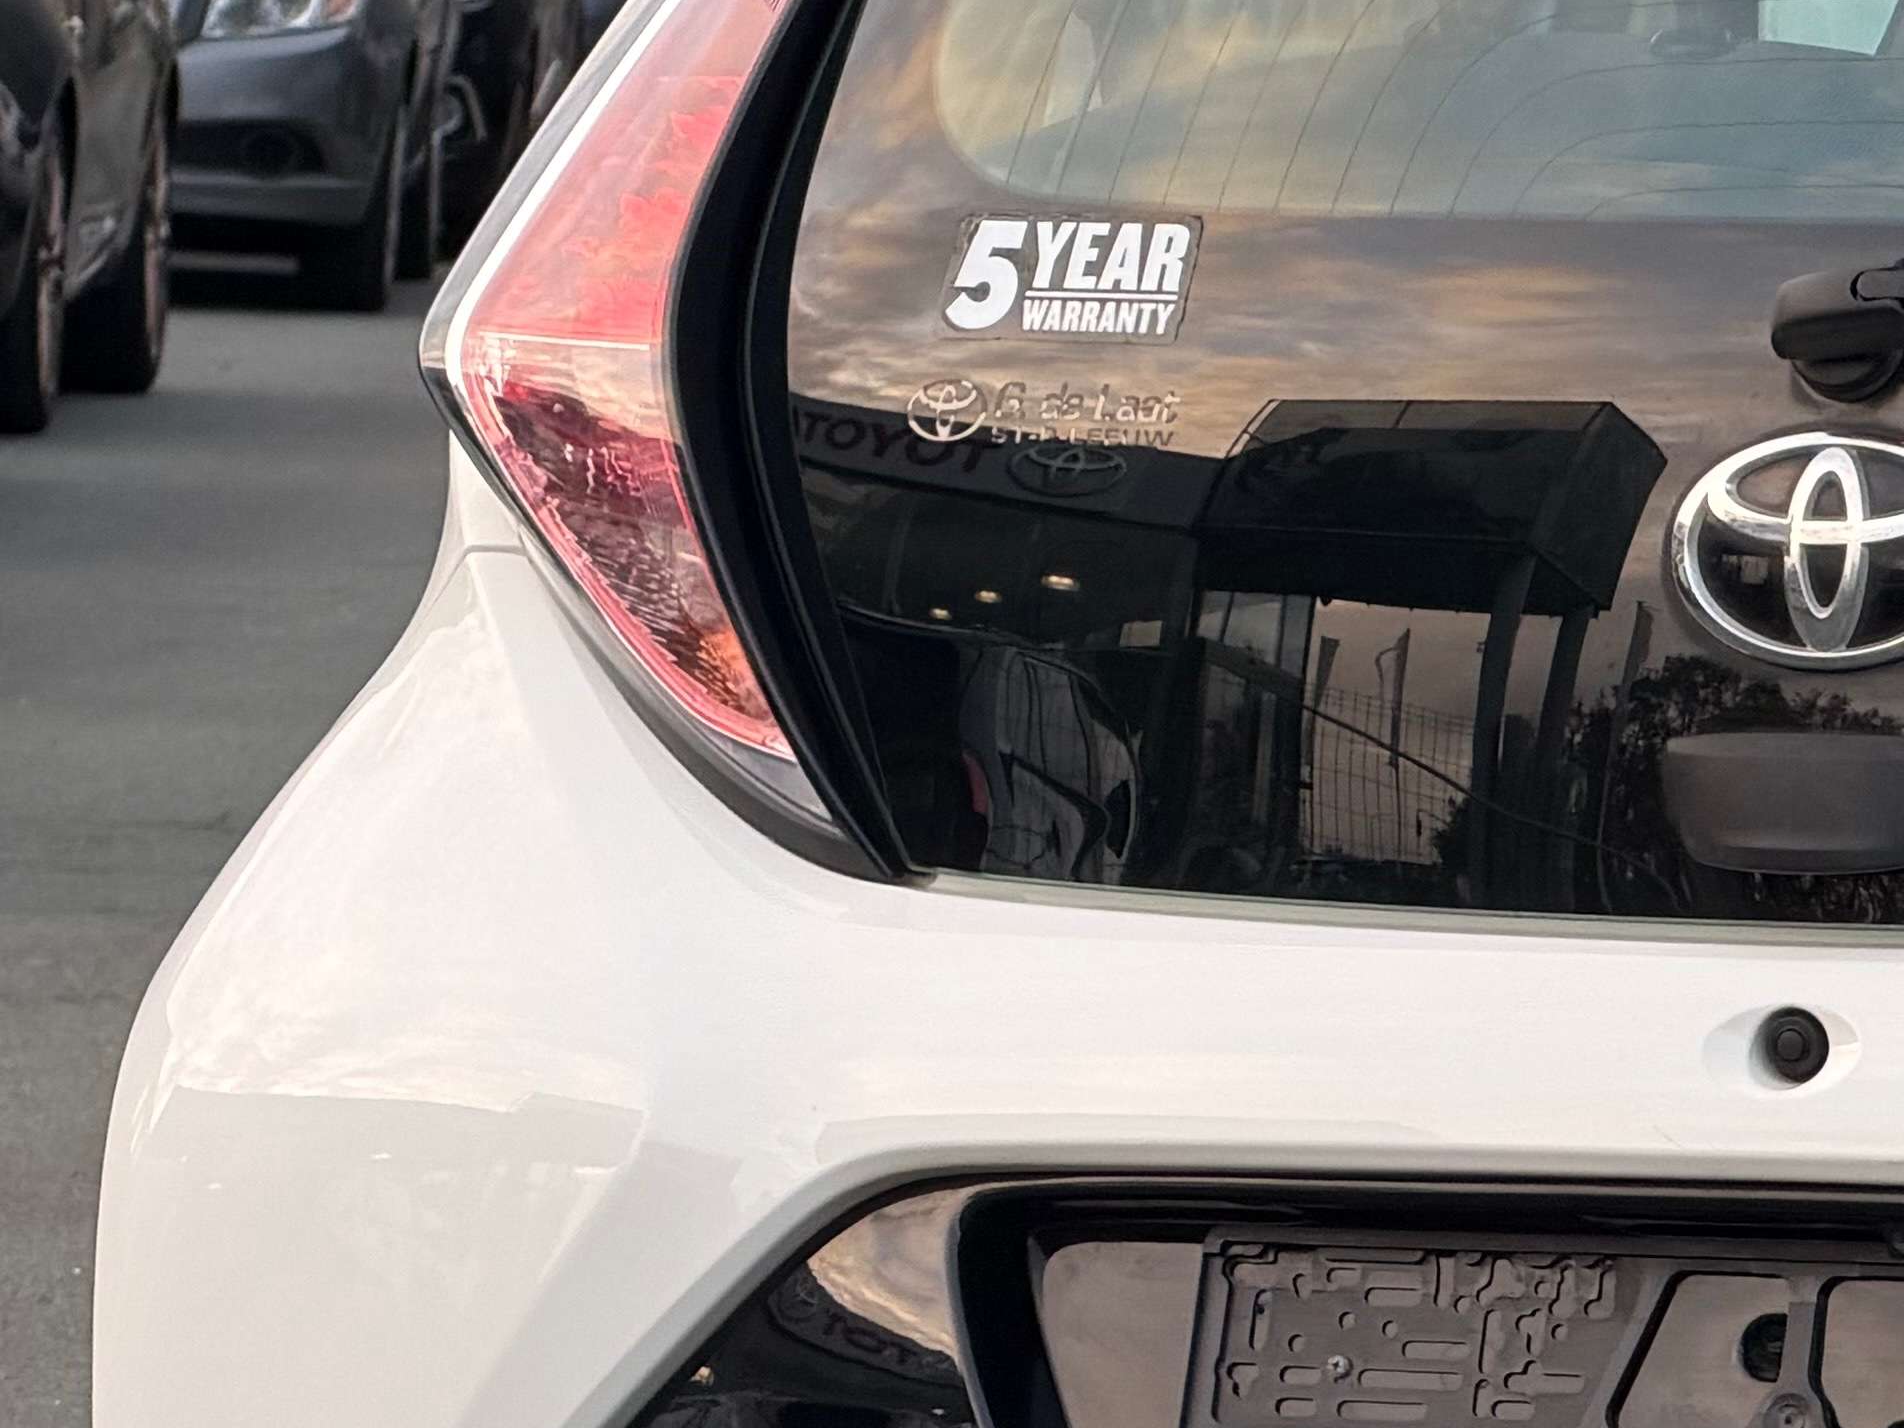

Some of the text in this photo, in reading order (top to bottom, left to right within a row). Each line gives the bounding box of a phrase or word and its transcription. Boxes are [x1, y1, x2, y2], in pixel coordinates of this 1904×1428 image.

[944, 219, 1191, 330] 5 YEAR
[1022, 299, 1176, 334] WARRANTY
